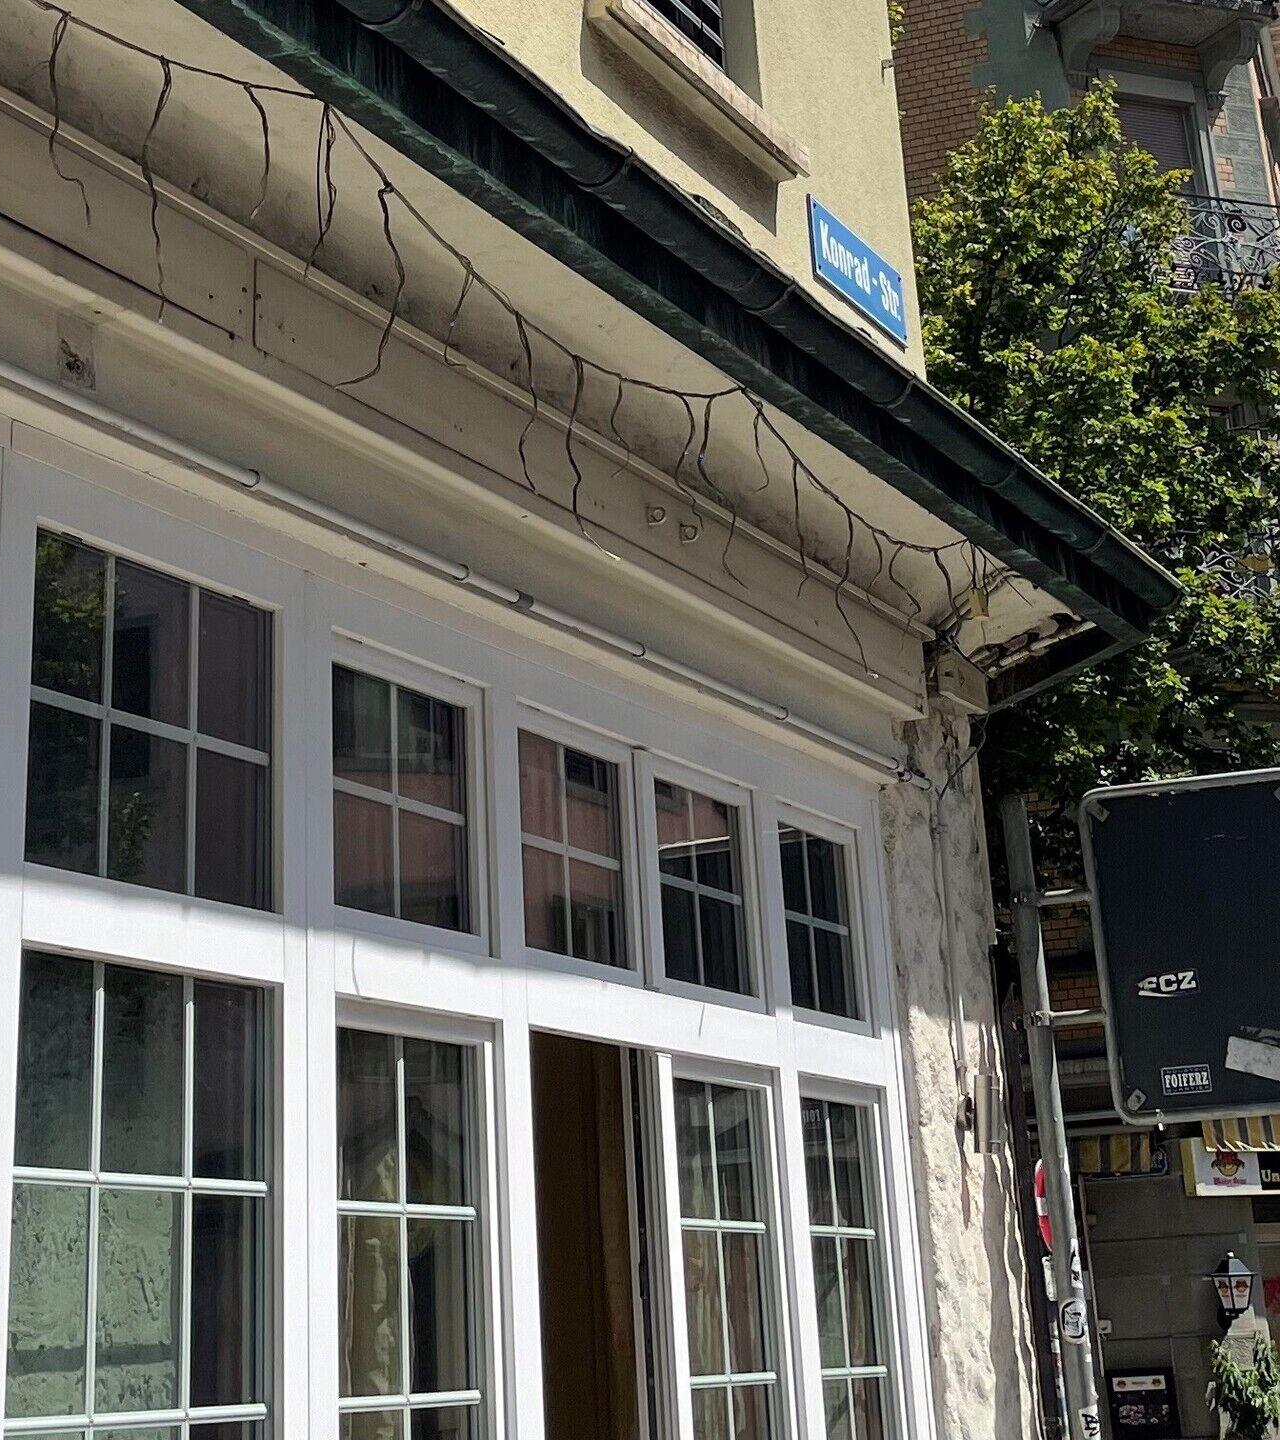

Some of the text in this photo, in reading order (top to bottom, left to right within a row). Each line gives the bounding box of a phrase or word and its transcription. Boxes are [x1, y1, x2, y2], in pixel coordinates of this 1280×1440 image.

[819, 219, 871, 296] Konrad
[878, 270, 902, 322] Str.
[1164, 1071, 1209, 1088] FOIFERZ
